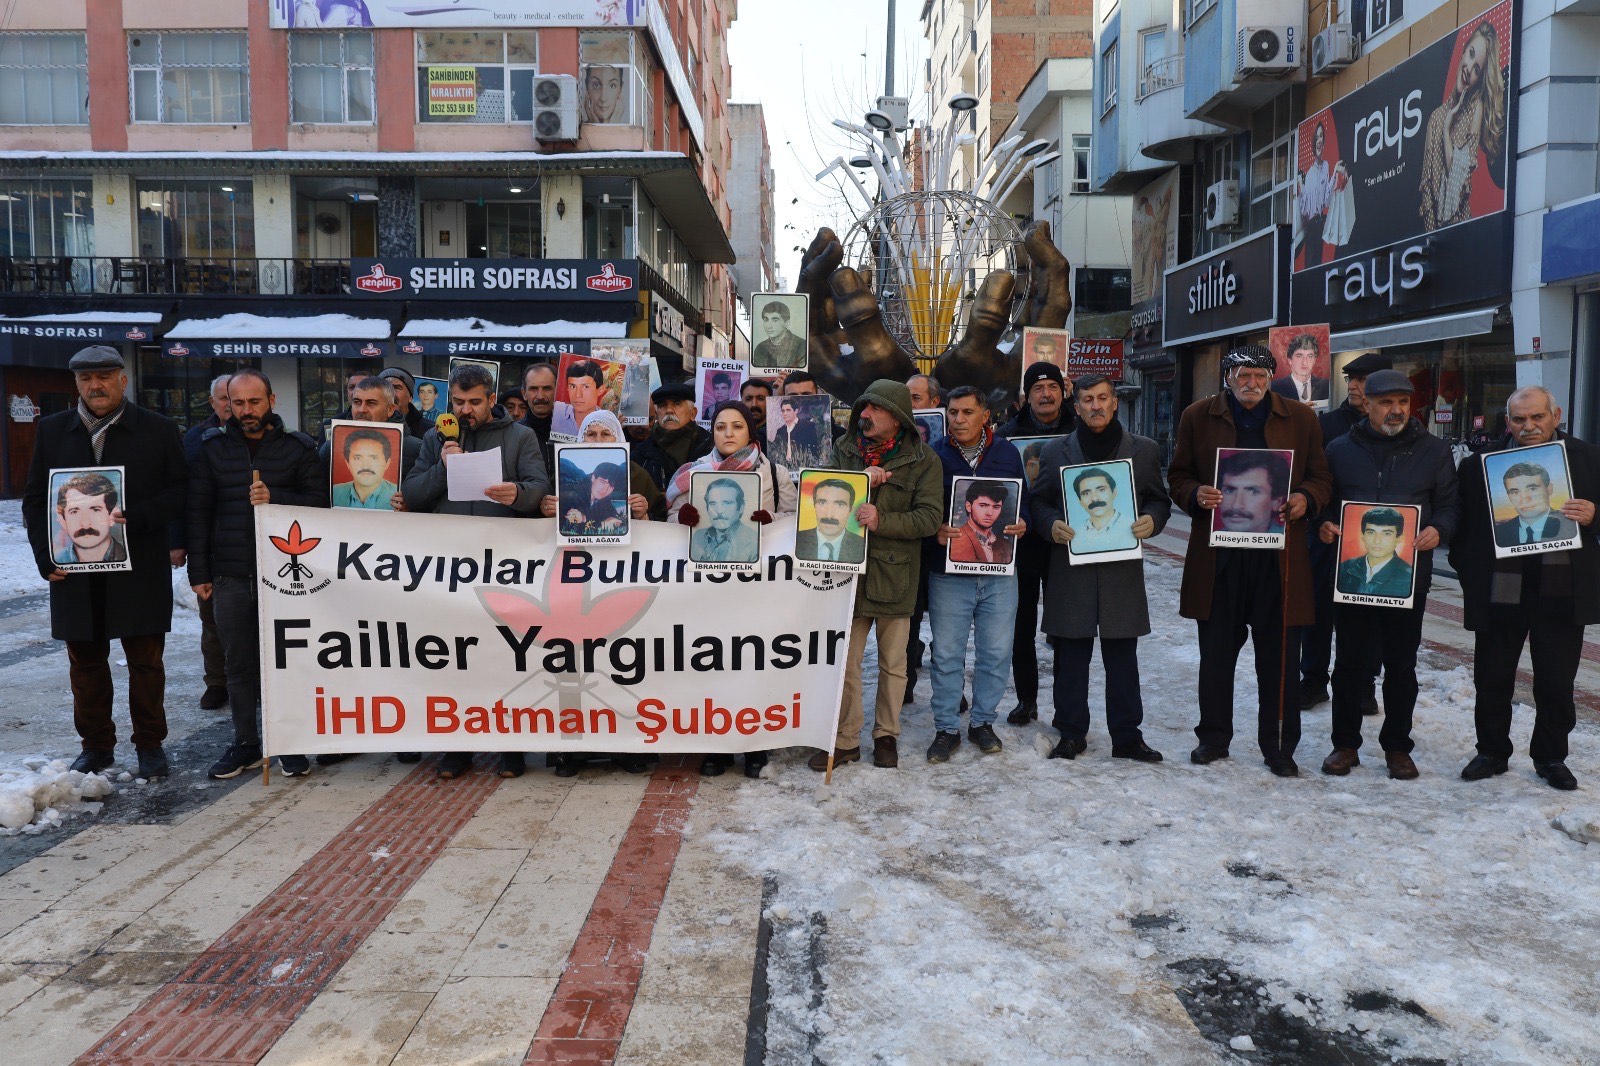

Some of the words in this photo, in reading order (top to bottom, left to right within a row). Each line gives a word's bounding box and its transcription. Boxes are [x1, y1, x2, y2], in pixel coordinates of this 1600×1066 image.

[493, 12, 518, 20] beauty
[524, 12, 551, 20] medical
[557, 12, 585, 20] esthetic
[1286, 27, 1294, 63] BEKO
[430, 69, 474, 81] SAHİBİNDEN
[431, 104, 445, 113] 0532
[446, 104, 458, 113] 553
[1353, 89, 1423, 163] rays
[361, 277, 396, 289] şenpiliç
[409, 260, 476, 295] ŞEHİR
[482, 267, 578, 290] SOFRASI
[591, 276, 627, 289] şenpiliç
[1325, 245, 1424, 308] rays
[1188, 259, 1237, 315] stilife
[34, 327, 103, 338] SOFRASI
[212, 342, 263, 356] ŞEHİR
[267, 344, 337, 354] SOFRASI
[448, 340, 498, 354] ŞEHİR
[502, 343, 574, 354] SOFRASI
[1069, 341, 1111, 356] Şirin
[701, 360, 720, 368] EDİP
[721, 362, 744, 370] ÇELİK
[1067, 356, 1119, 365] ollection
[550, 432, 575, 442] MEHMET
[1215, 534, 1250, 544] Hüseyin
[1252, 534, 1279, 544] SEVİM
[1510, 544, 1540, 554] RESUL
[1542, 540, 1573, 550] SAÇAN
[337, 541, 545, 592] Kayıplar
[695, 562, 728, 570] İBRAHİM
[730, 563, 753, 572] ÇELİK
[822, 564, 860, 572] DEĞİRMENCİ
[954, 564, 978, 572] Yılmaz
[980, 564, 1007, 574] GÜMÜŞ
[309, 578, 332, 594] DERNEĞİ
[1342, 594, 1374, 603] M.ŞİRİN
[1376, 598, 1404, 606] MALTU
[273, 619, 479, 671] Failler
[315, 687, 406, 735] İHD
[426, 696, 617, 734] Batman
[635, 692, 801, 744] Şubesi
